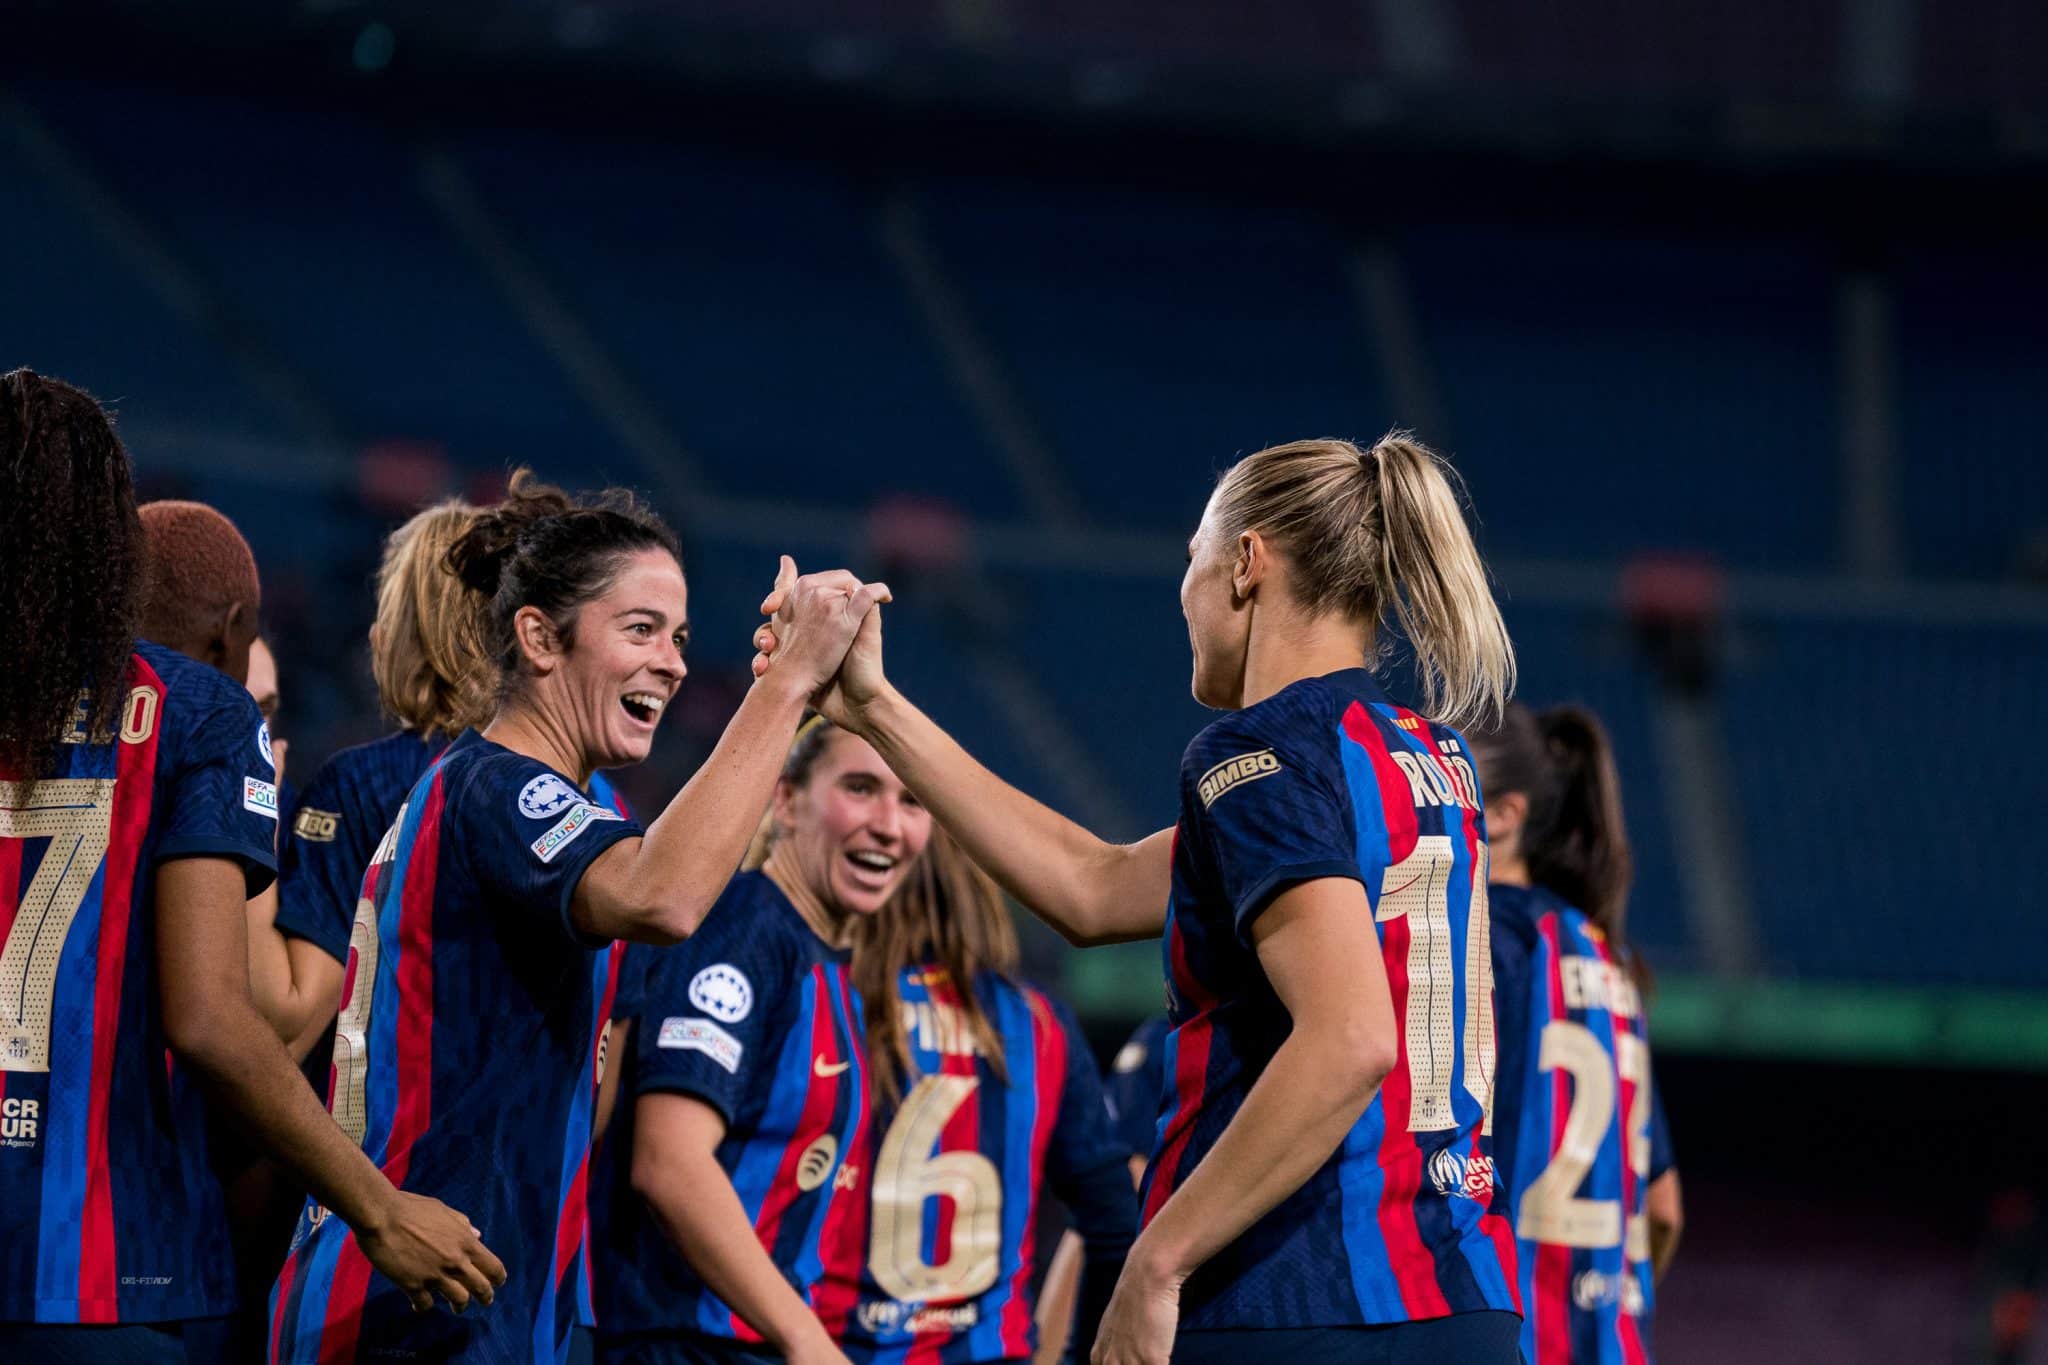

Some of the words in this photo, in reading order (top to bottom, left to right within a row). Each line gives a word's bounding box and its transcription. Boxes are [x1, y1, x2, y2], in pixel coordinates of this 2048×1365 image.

[1199, 753, 1278, 806] BIMBO
[0, 779, 118, 1072] 7
[868, 1073, 1003, 1302] 6
